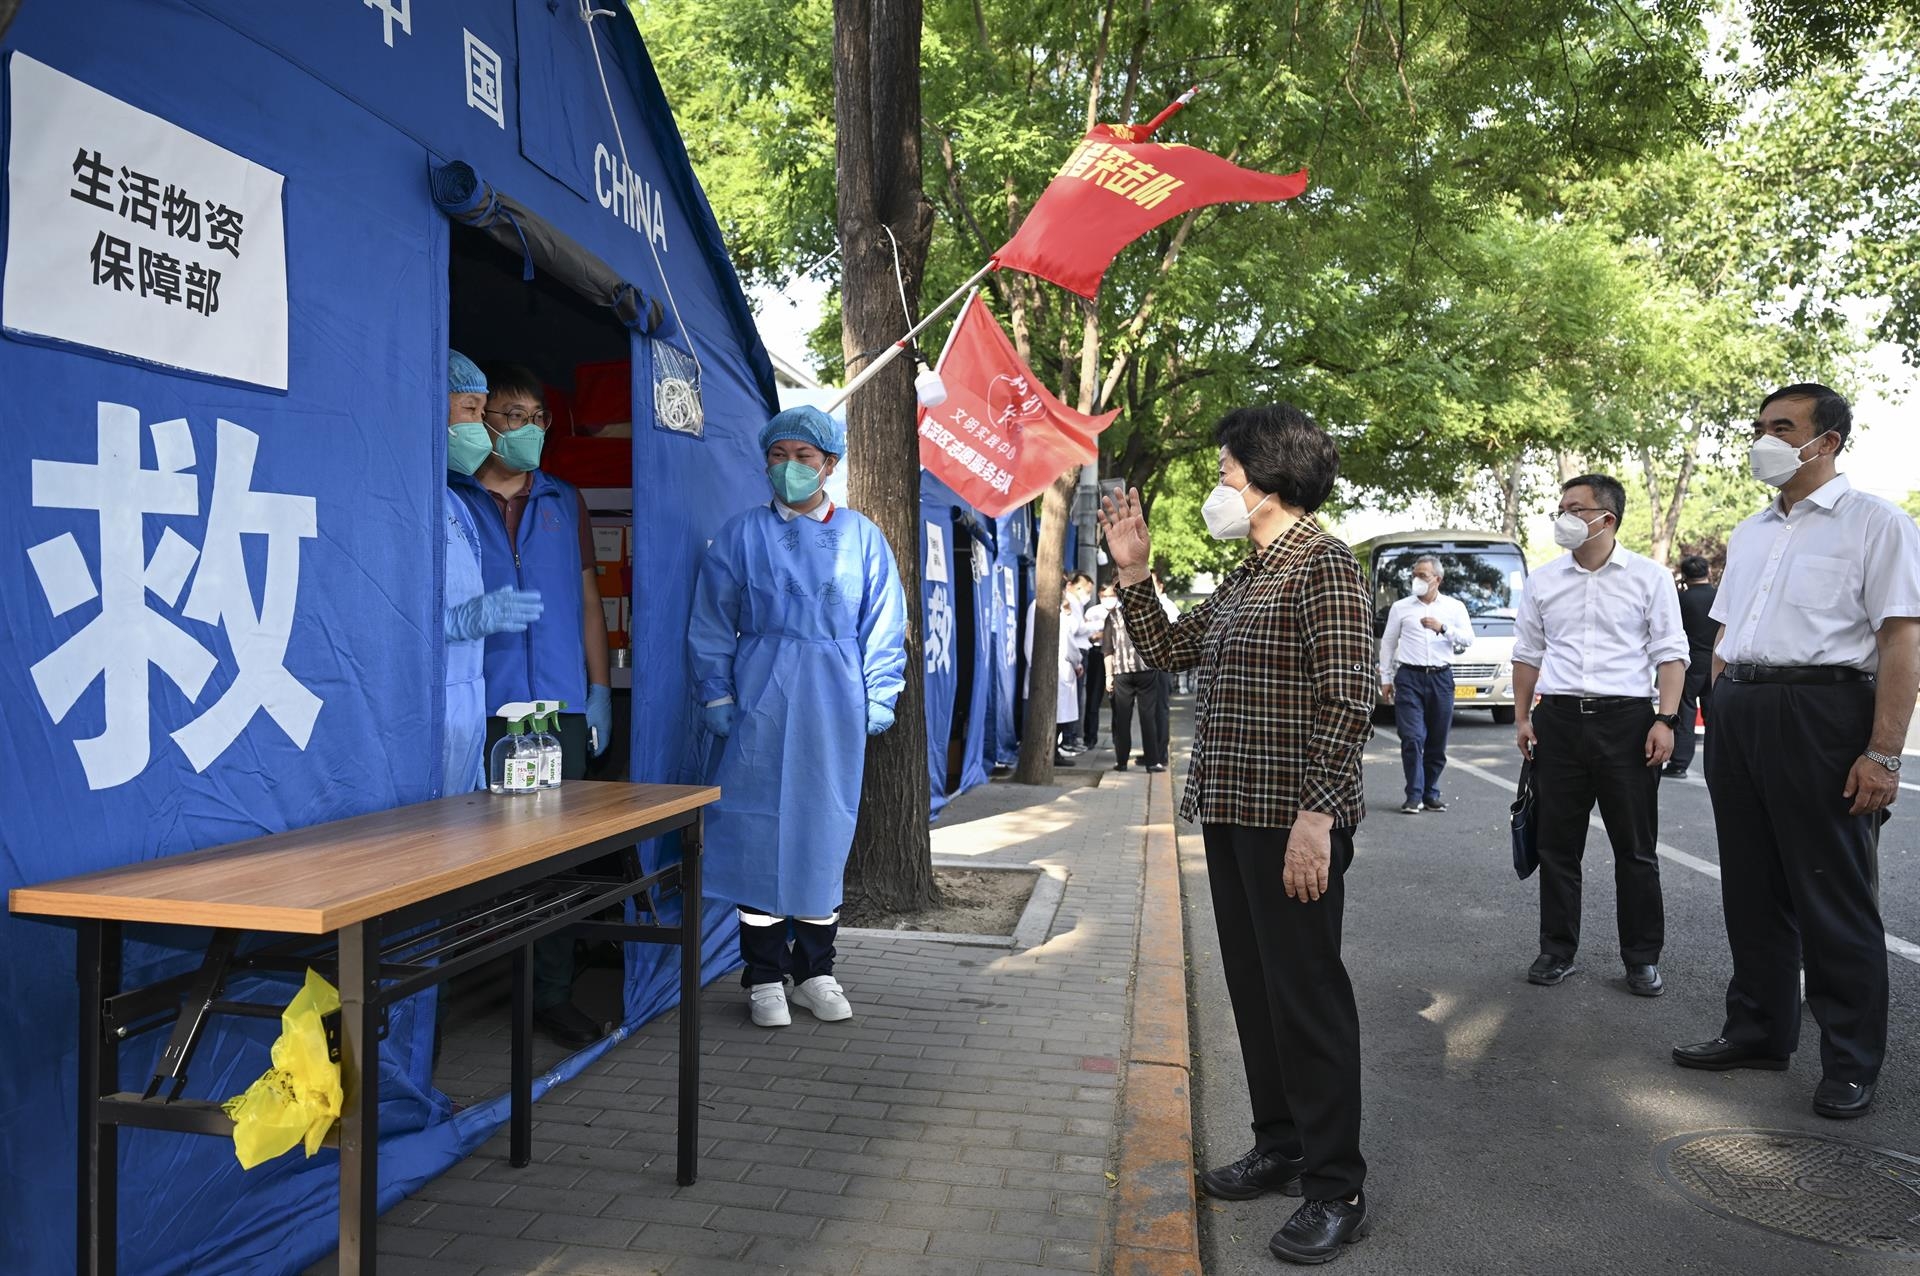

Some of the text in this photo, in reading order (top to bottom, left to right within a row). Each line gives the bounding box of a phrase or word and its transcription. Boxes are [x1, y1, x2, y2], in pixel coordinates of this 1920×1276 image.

[70, 147, 244, 259] 生活物资
[594, 142, 668, 253] CHINA
[89, 231, 222, 317] 保障部
[26, 400, 324, 791] 救
